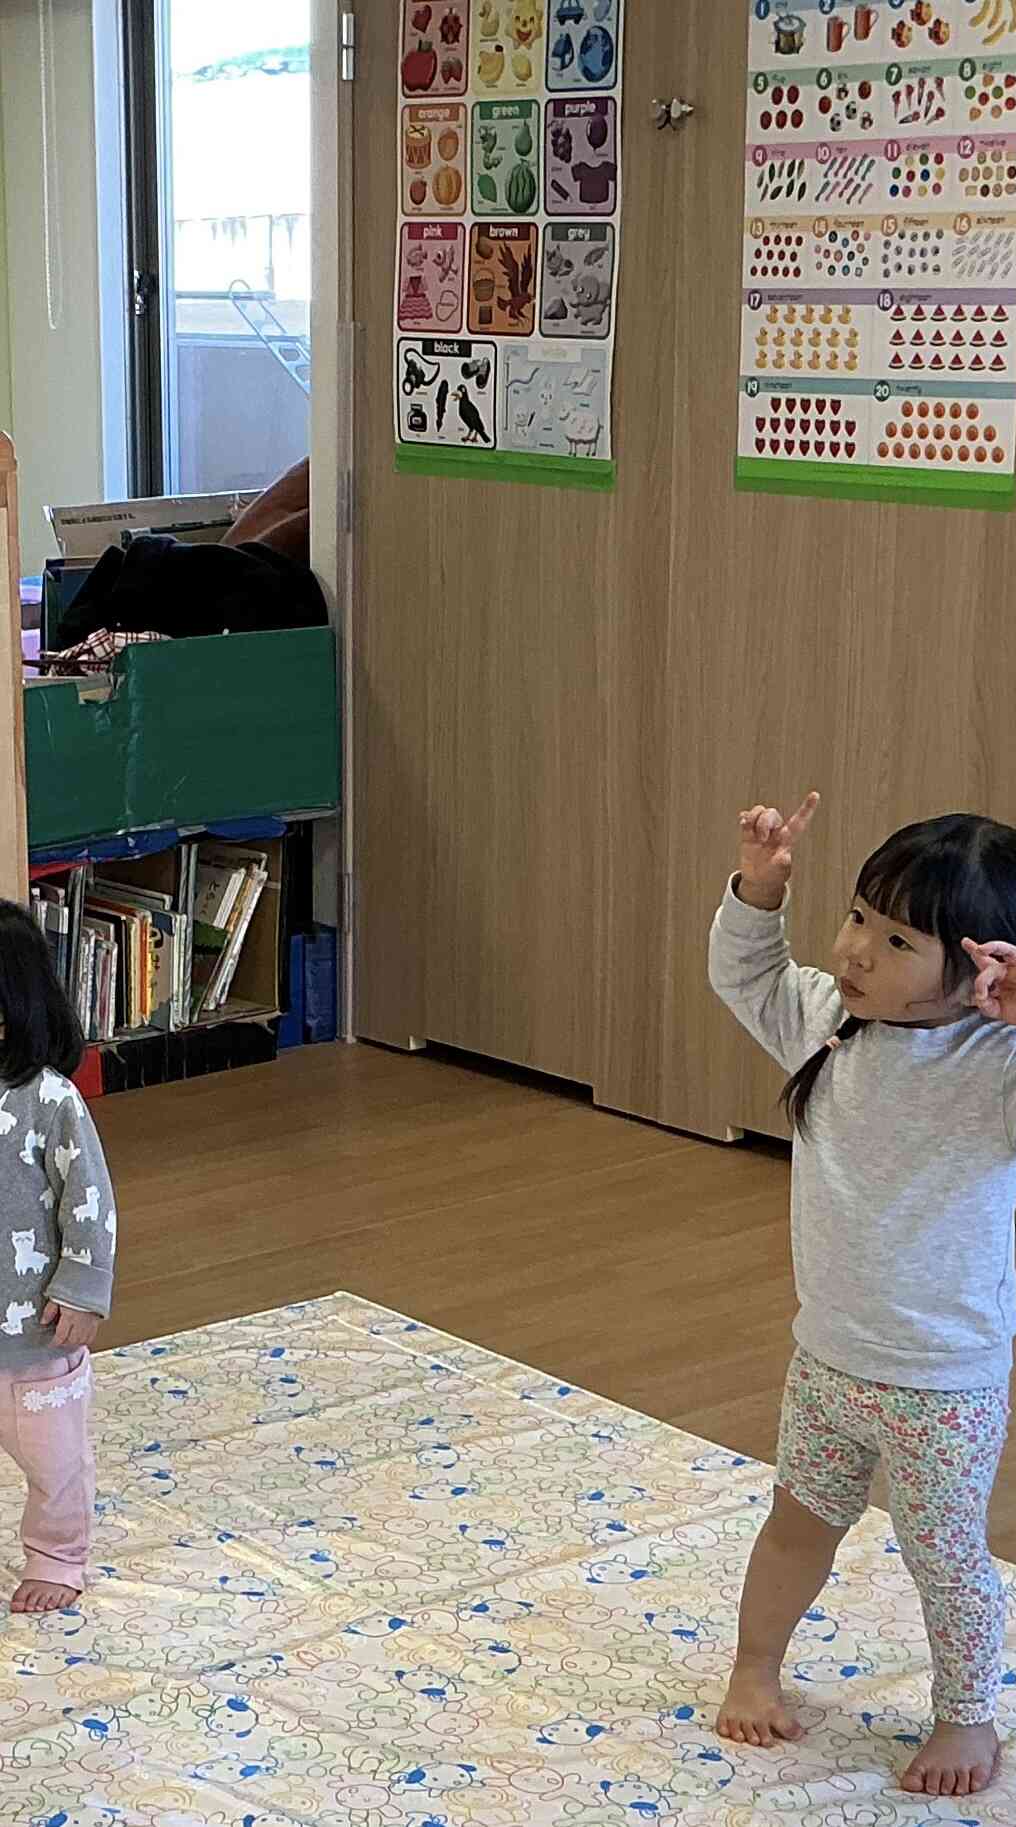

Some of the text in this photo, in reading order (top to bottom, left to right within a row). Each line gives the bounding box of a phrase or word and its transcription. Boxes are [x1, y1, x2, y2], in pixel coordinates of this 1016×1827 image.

[418, 107, 450, 121] orange
[492, 104, 520, 118] green
[564, 100, 597, 116] purple
[816, 146, 830, 161] 10
[887, 143, 899, 158] 11
[960, 140, 972, 155] 12
[423, 224, 444, 239] pink
[489, 223, 519, 238] brown
[752, 220, 763, 236] 13
[815, 219, 828, 235] 14
[882, 218, 895, 234] 15
[955, 217, 968, 232] 16
[567, 225, 592, 241] grey
[749, 292, 761, 308] 17
[878, 292, 892, 309] 18
[433, 341, 460, 355] black
[747, 379, 759, 395] 19
[875, 384, 890, 398] 20
